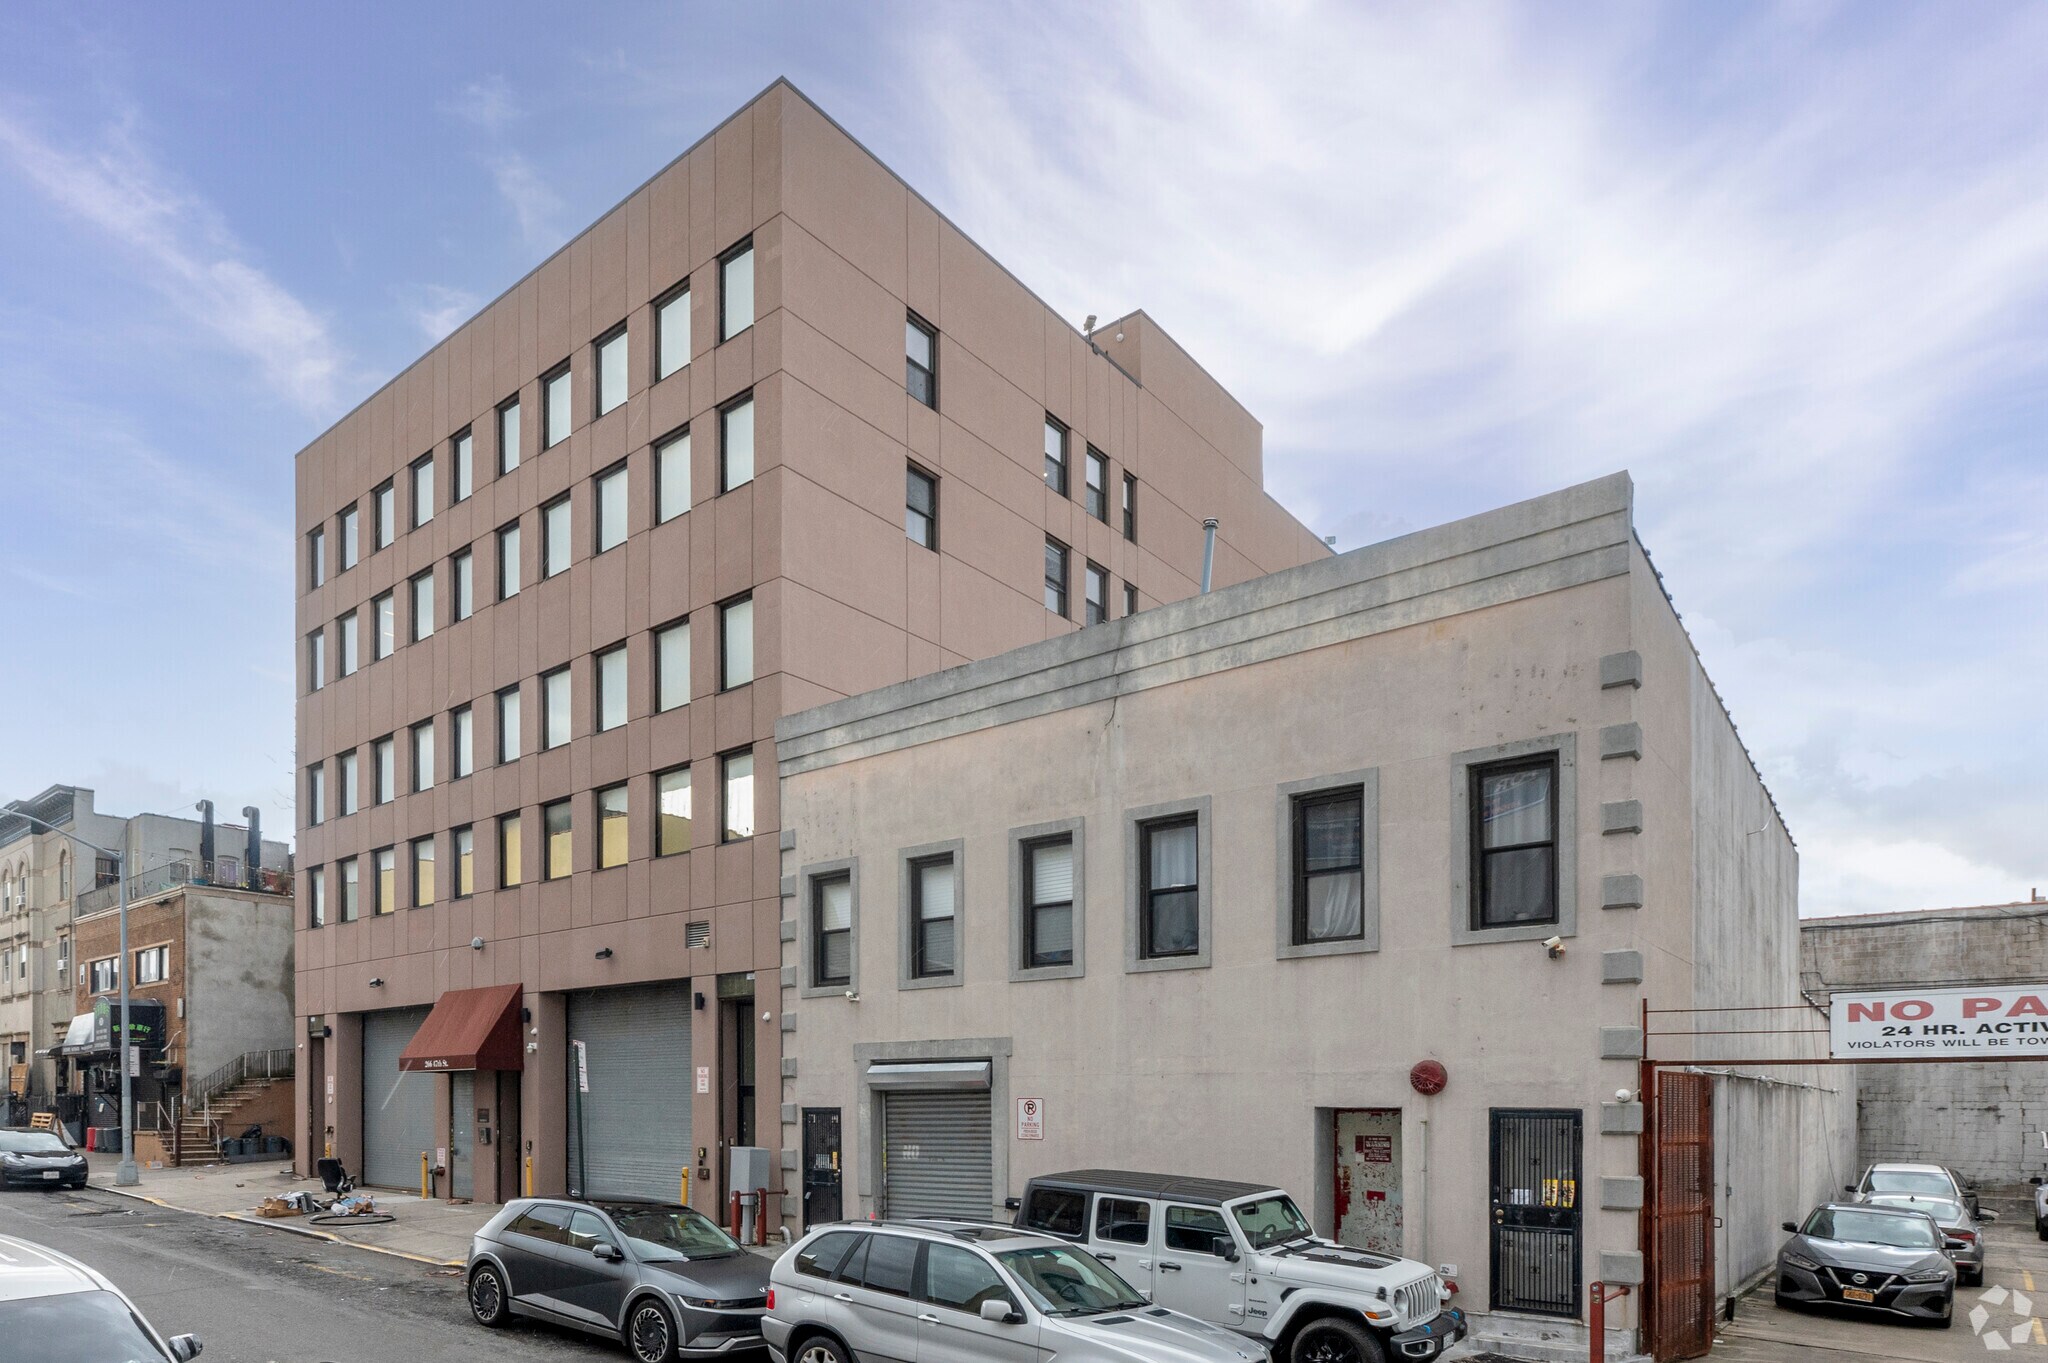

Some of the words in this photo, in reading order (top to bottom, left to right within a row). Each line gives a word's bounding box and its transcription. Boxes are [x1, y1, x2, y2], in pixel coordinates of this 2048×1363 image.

[1848, 1000, 1934, 1023] NO
[1962, 995, 2048, 1019] PA
[1881, 1026, 1913, 1037] 24
[1923, 1025, 1966, 1036] HR.
[1848, 1040, 1935, 1049] VIOLATORS
[1943, 1039, 1981, 1047] WILL
[1988, 1038, 2009, 1046] BE
[1247, 1307, 1268, 1317] Jeep
